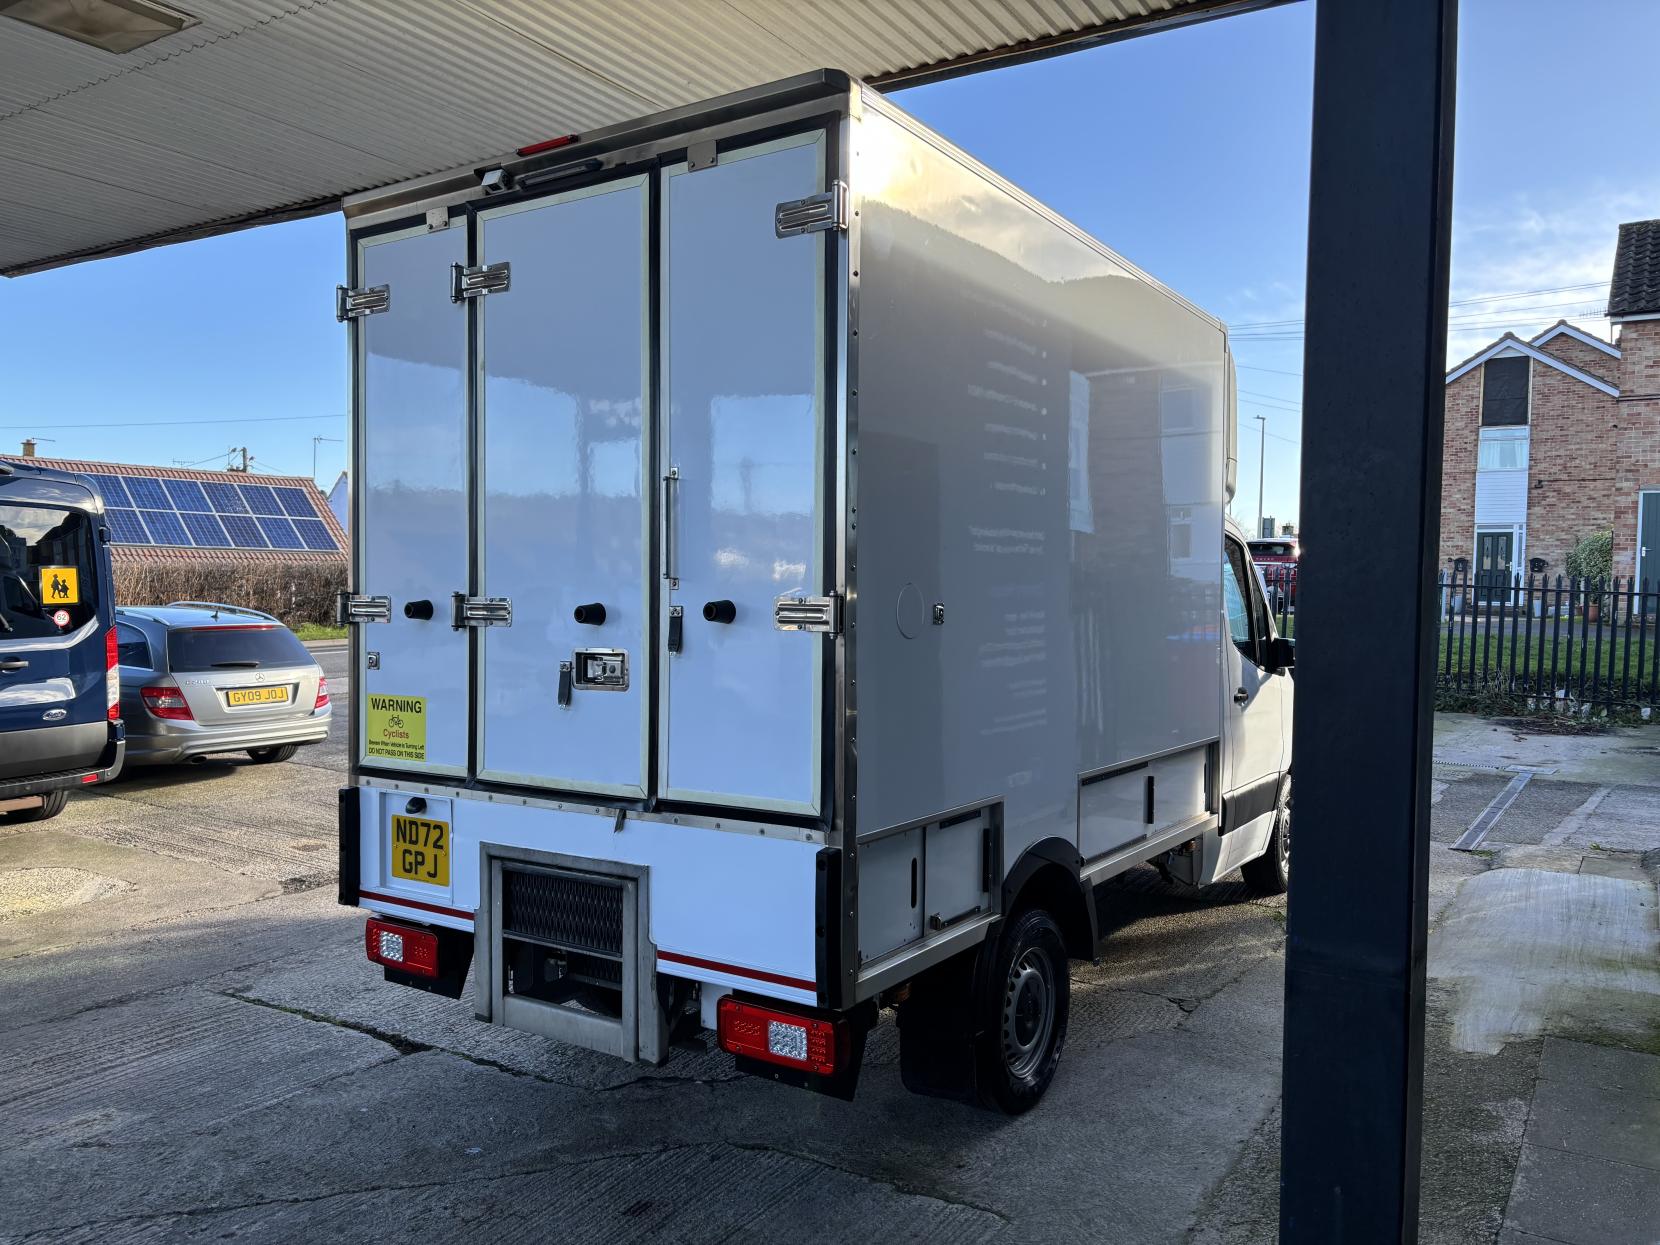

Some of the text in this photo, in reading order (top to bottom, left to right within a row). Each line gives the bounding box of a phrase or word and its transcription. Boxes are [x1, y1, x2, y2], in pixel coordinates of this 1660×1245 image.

[233, 690, 262, 702] GY09
[371, 698, 422, 714] WARNING
[383, 728, 410, 740] Cyclists
[396, 817, 444, 850] ND72
[402, 848, 438, 879] GPJ
